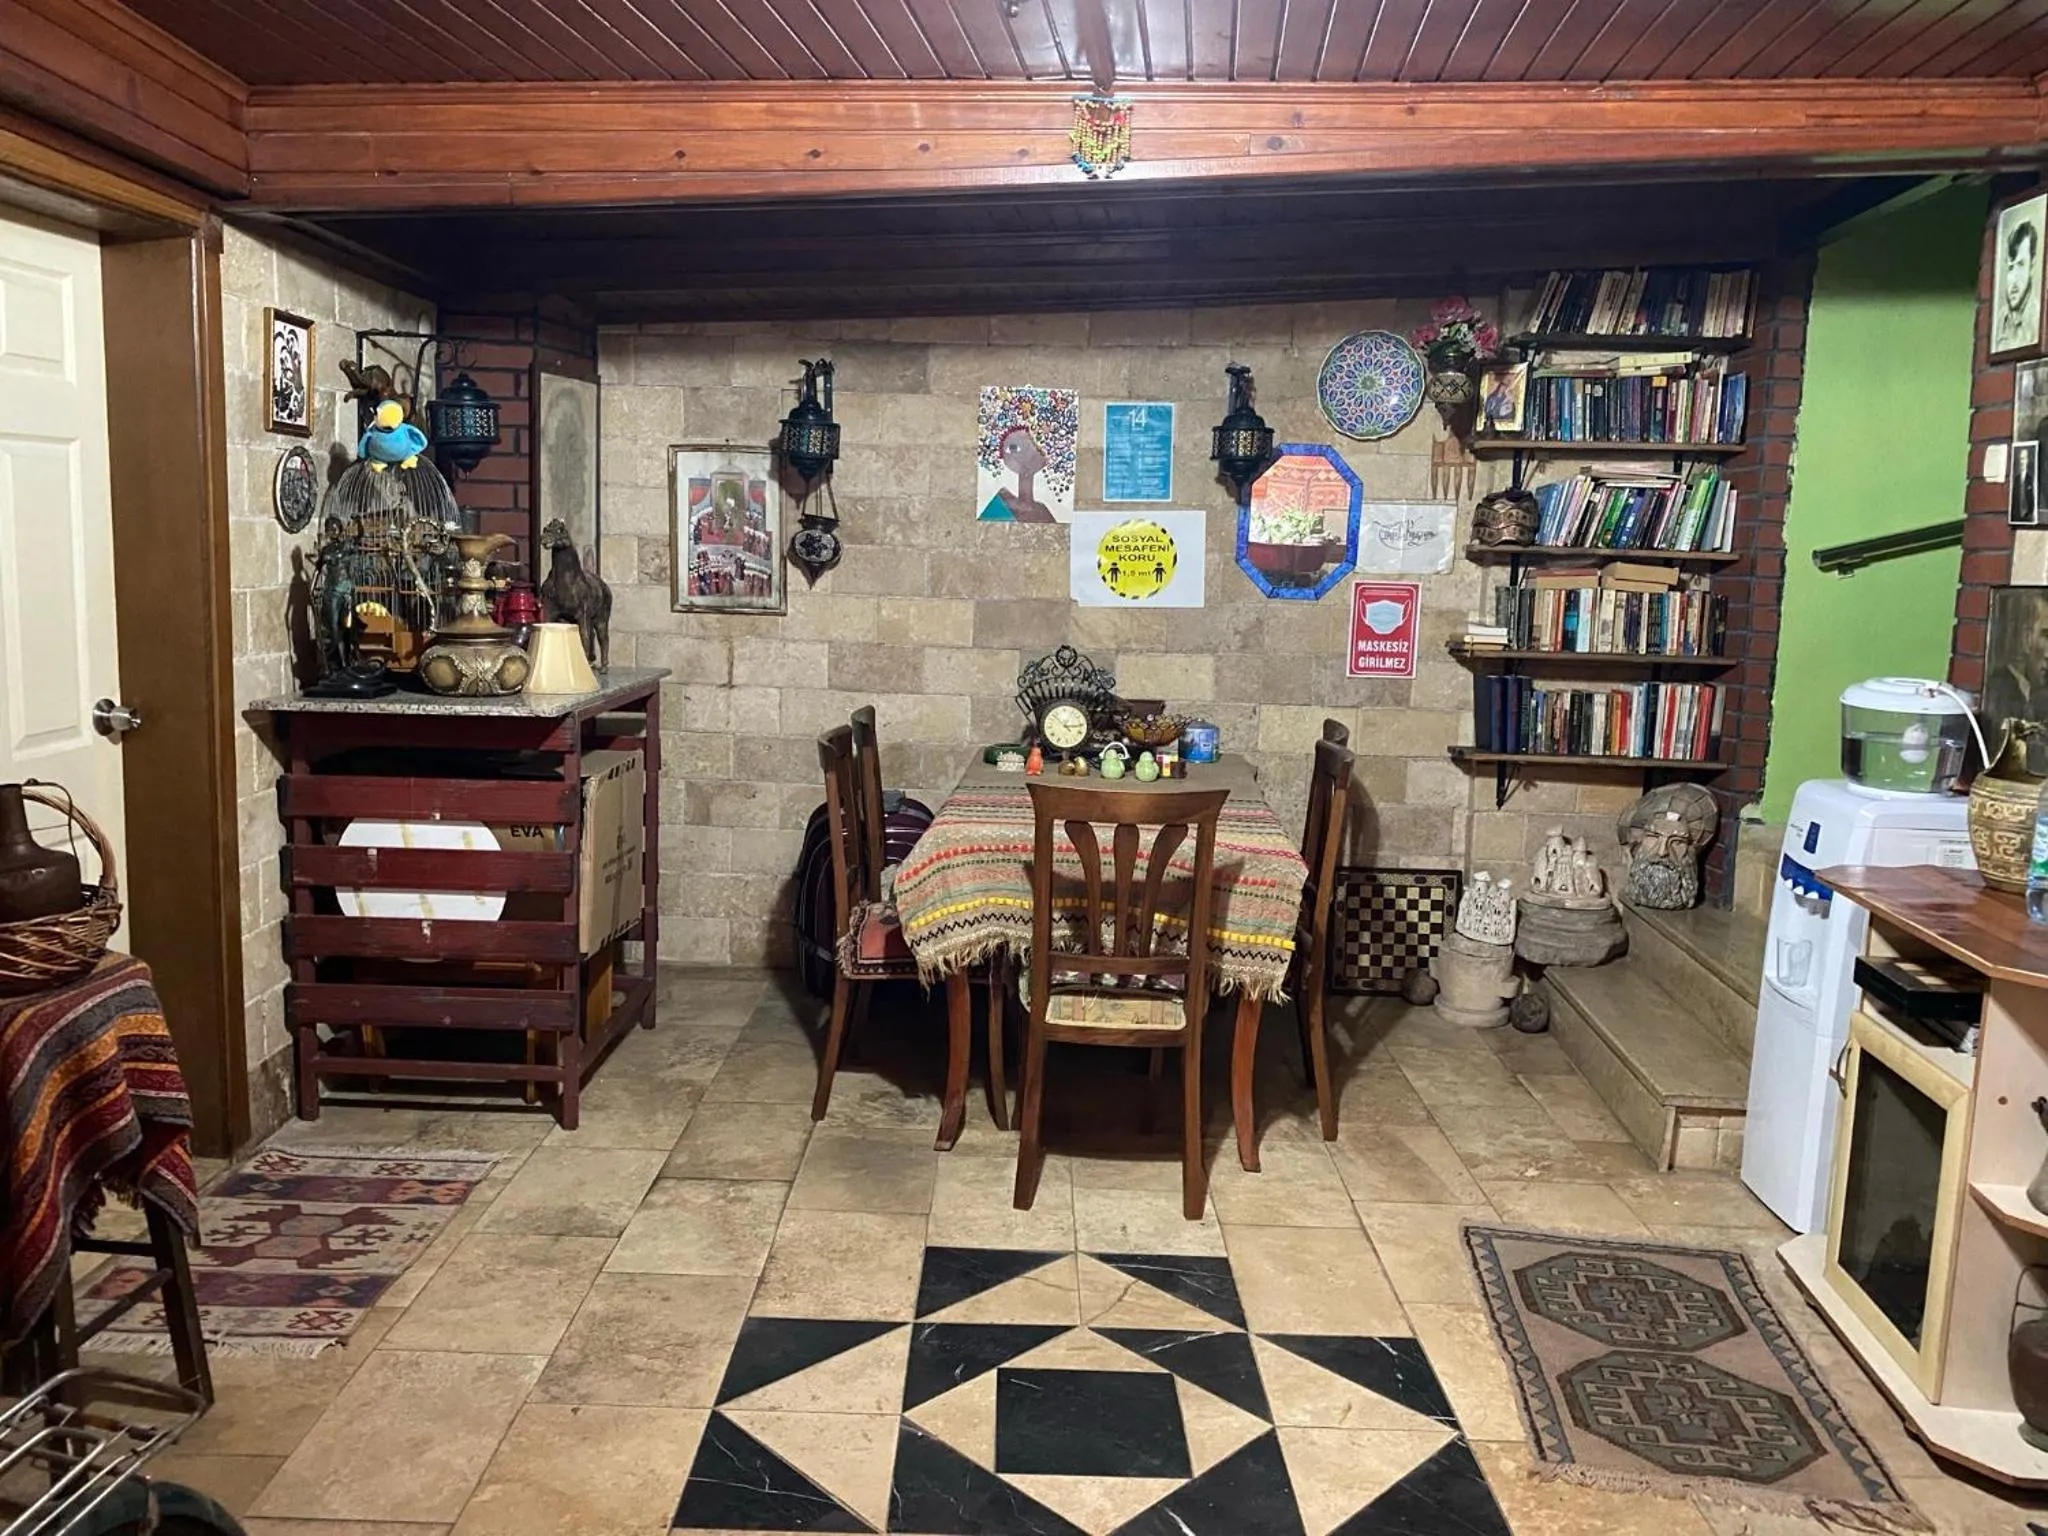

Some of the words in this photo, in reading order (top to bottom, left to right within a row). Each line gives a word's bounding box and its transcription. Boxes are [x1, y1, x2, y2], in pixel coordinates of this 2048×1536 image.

[1128, 407, 1147, 428] 14
[1111, 534, 1164, 543] SOSYAL
[1118, 553, 1156, 562] KORU
[1357, 639, 1409, 653] MASKESİZ
[1358, 654, 1406, 669] GİRİLMEZ
[510, 824, 545, 839] EVA
